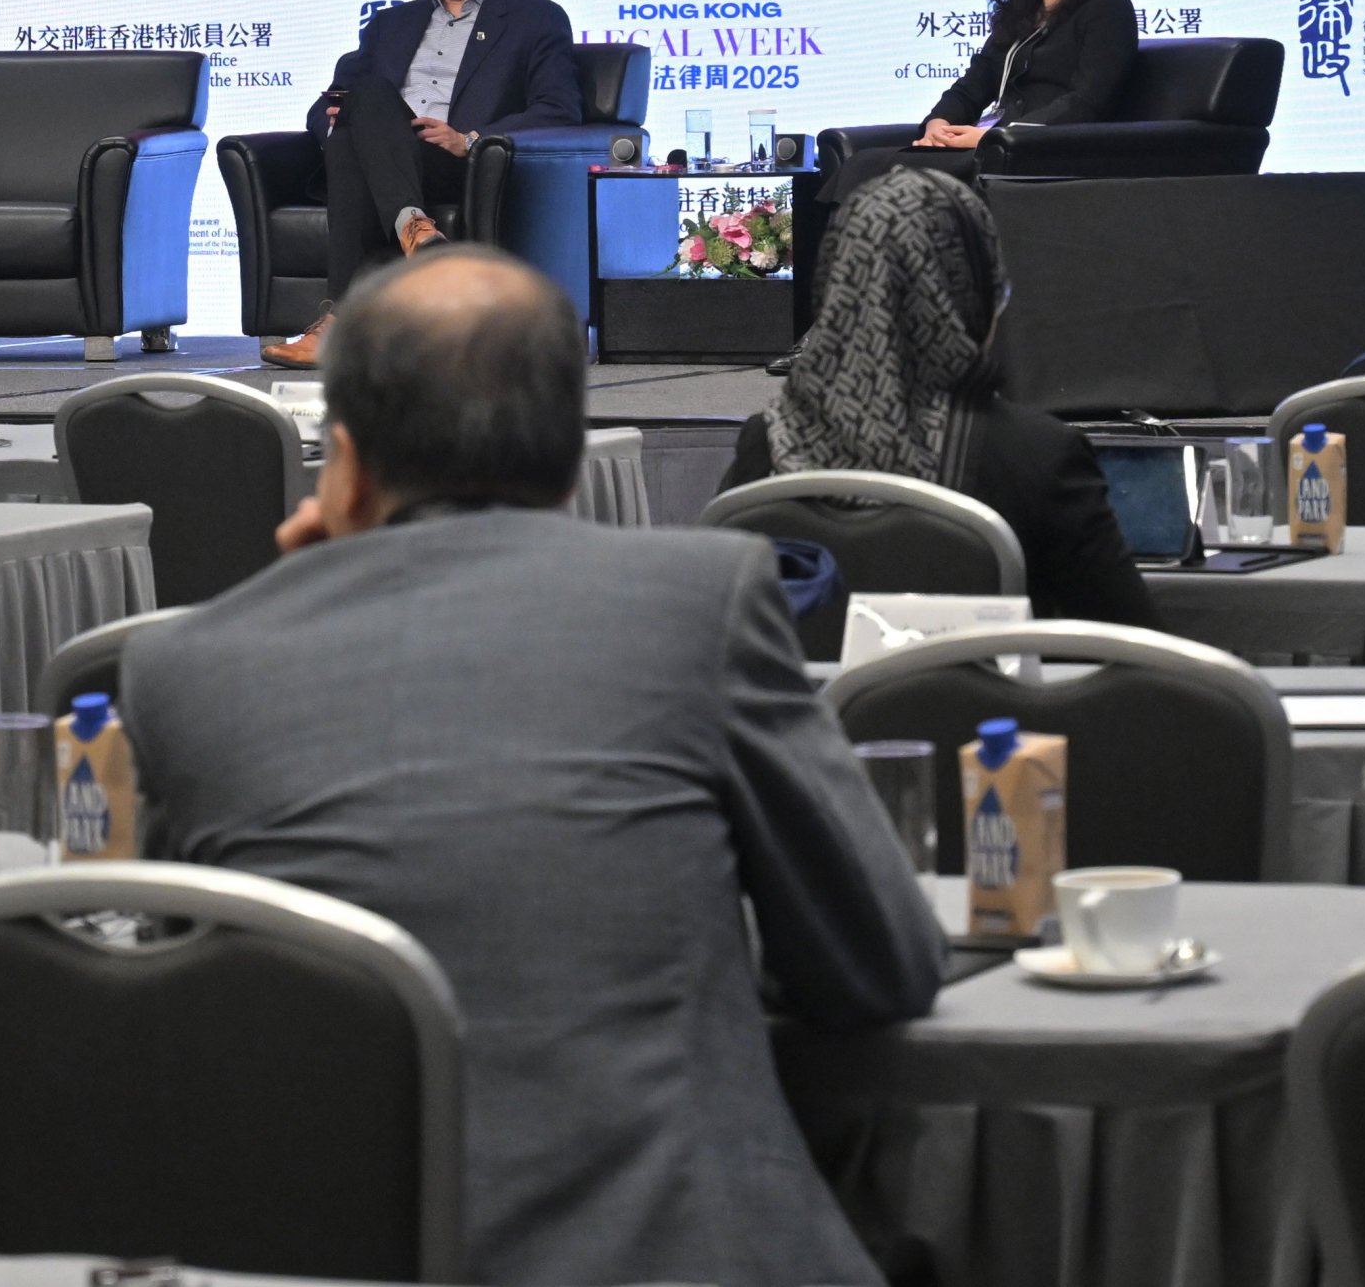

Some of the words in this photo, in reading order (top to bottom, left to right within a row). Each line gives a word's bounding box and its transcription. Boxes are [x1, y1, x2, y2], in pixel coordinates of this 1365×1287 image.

[619, 3, 699, 20] HONG
[704, 2, 782, 19] KONG
[210, 73, 232, 87] the
[237, 72, 293, 87] HKSAR
[1298, 478, 1330, 499] LAND
[1298, 499, 1330, 521] PARK
